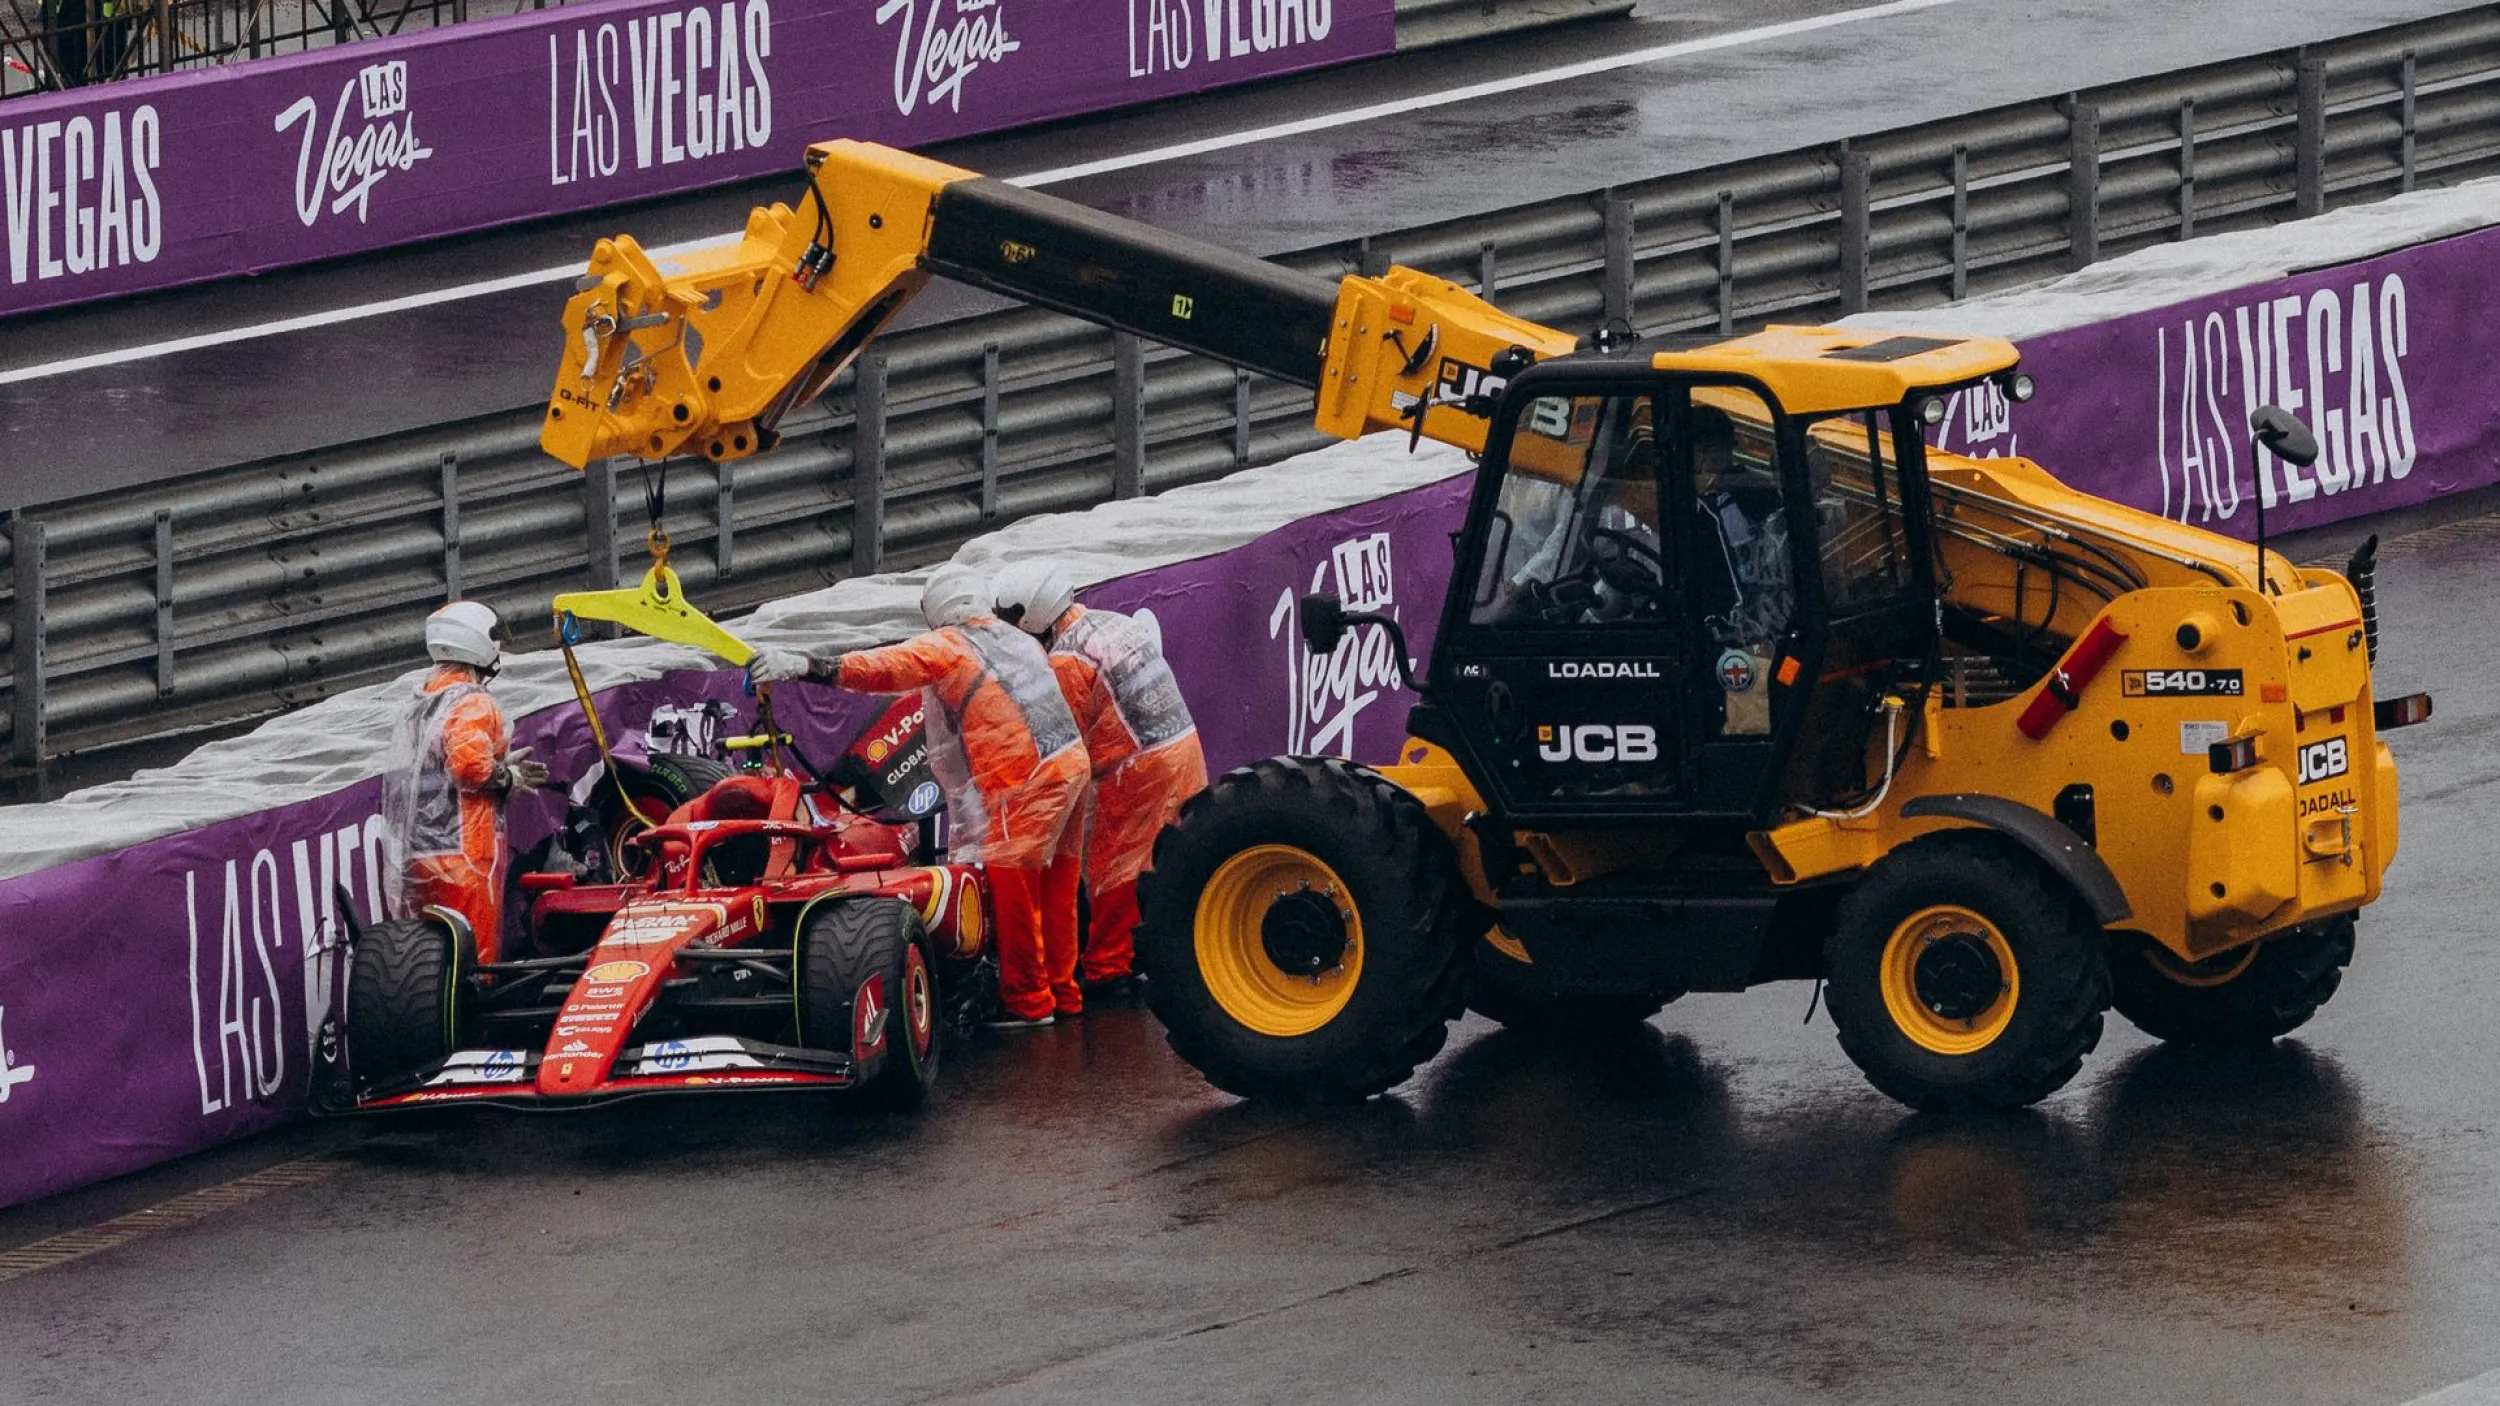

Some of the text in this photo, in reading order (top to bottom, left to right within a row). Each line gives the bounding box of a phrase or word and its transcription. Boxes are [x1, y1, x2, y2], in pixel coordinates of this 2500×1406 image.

[362, 64, 405, 113] LAS
[876, 0, 1019, 115] Vegas
[550, 0, 771, 185] LAS VEGAS
[275, 79, 432, 226] Vegas
[2, 104, 160, 284] VEGAS
[1967, 379, 2007, 435] LAS
[2159, 273, 2416, 524] LAS VEGAS
[1336, 535, 1391, 608] LAS
[1549, 662, 1660, 678] LOADALL
[883, 707, 924, 745] V-Po
[1539, 725, 1658, 762] JCB
[2299, 739, 2347, 783] JCB
[910, 783, 937, 813] hp
[187, 849, 284, 1115] LAS
